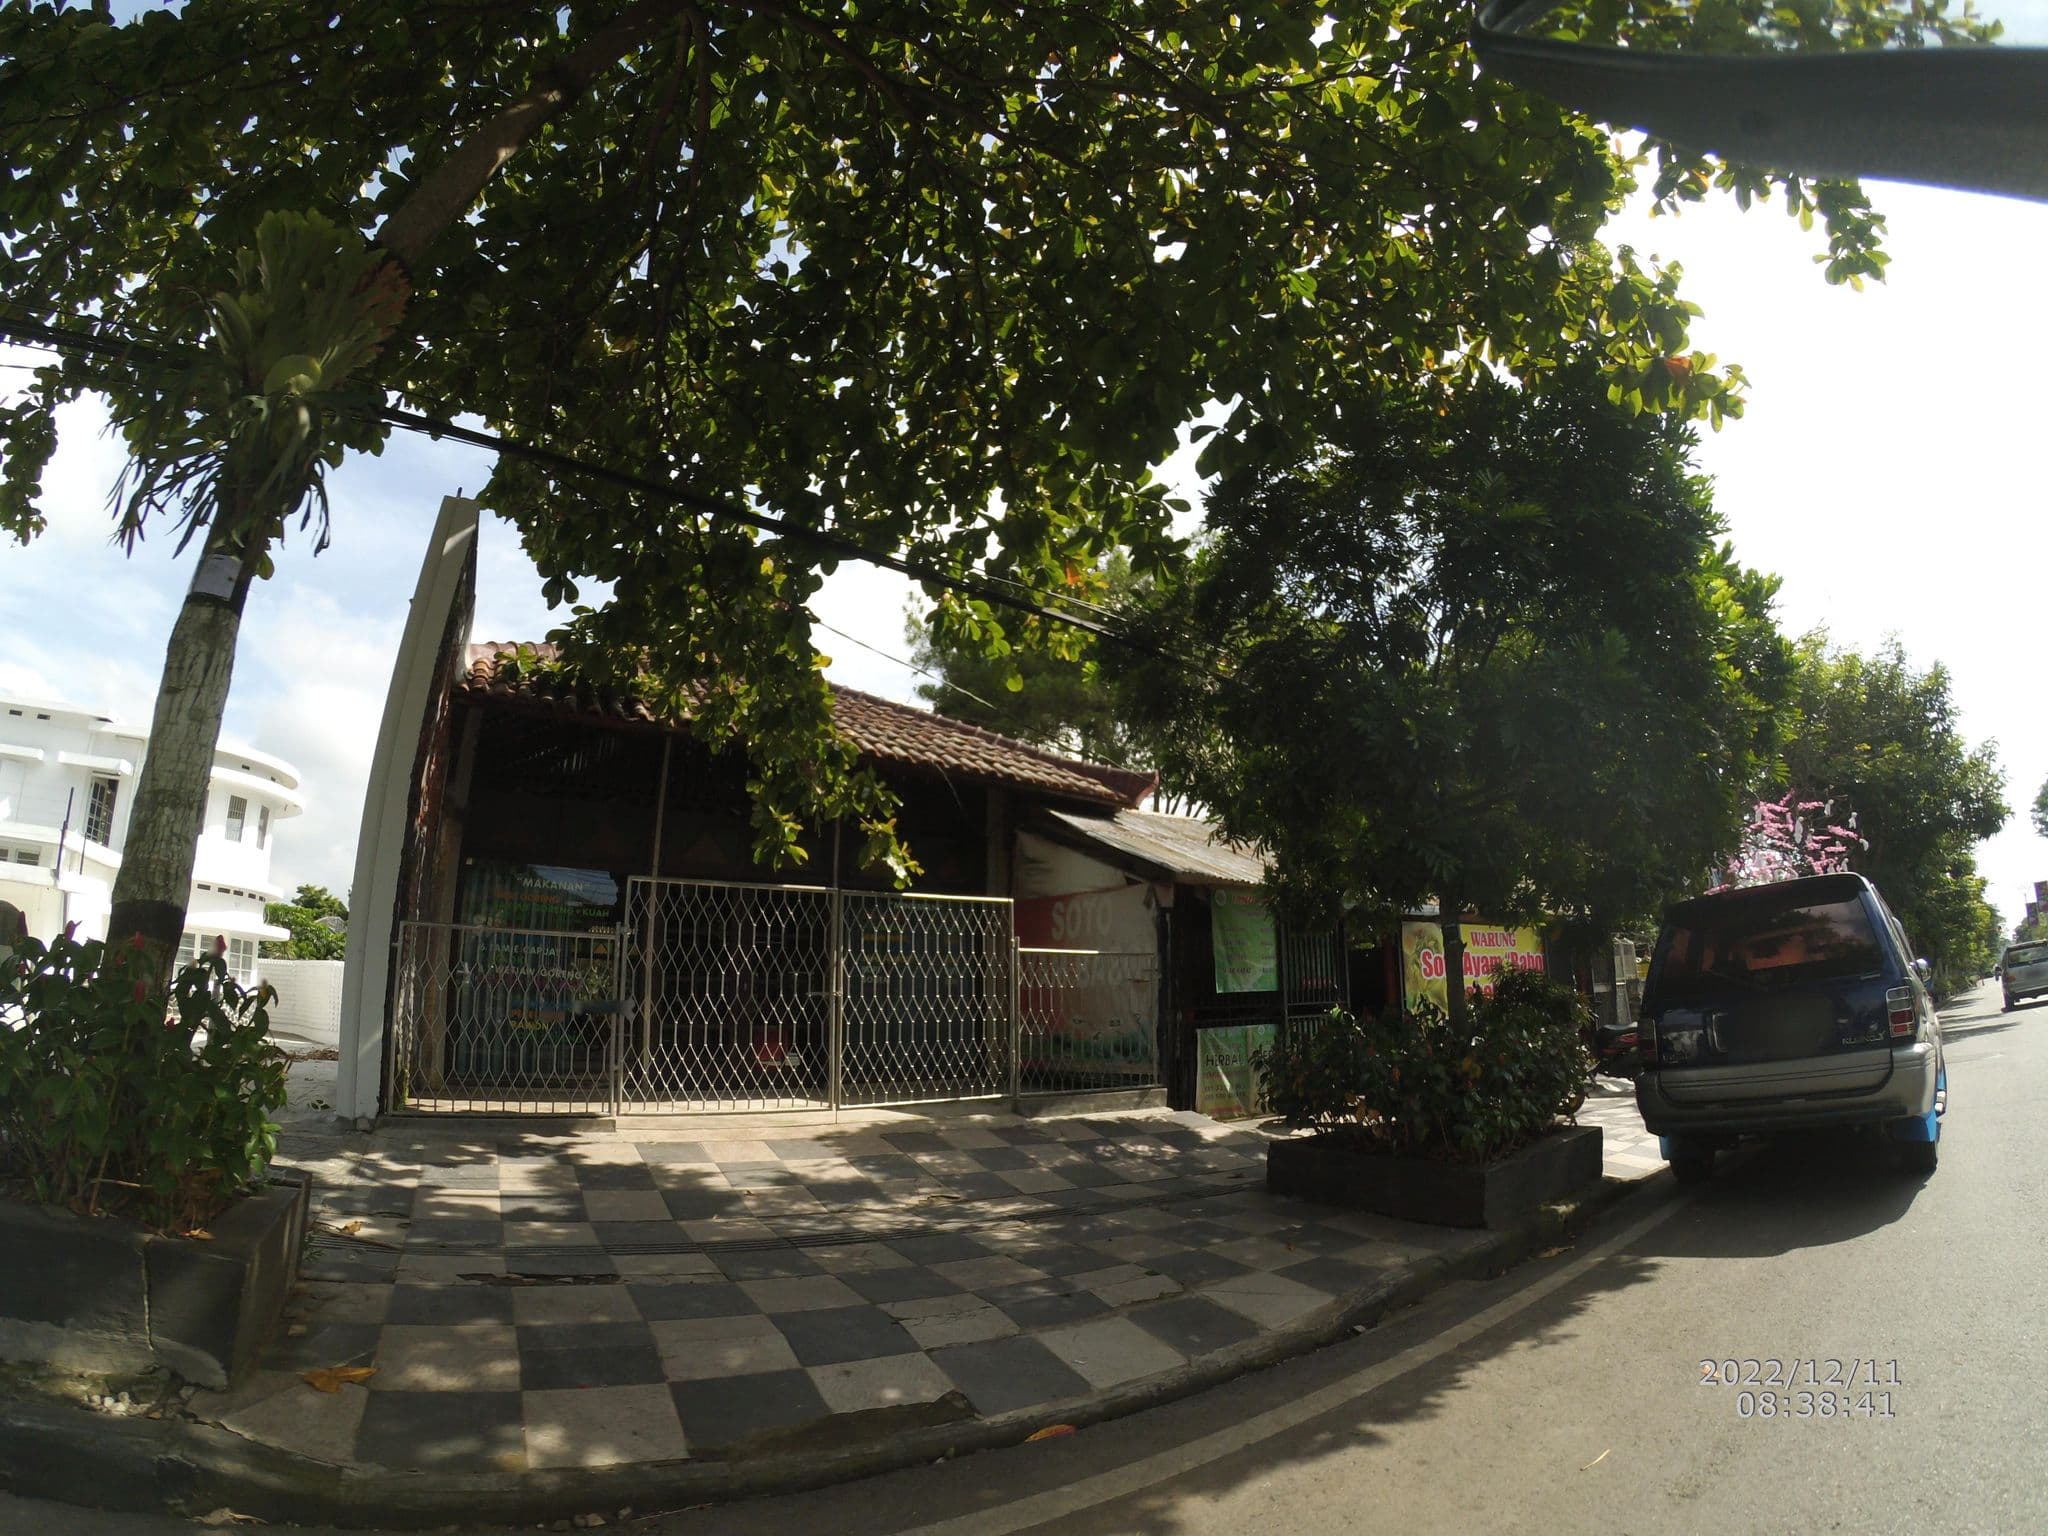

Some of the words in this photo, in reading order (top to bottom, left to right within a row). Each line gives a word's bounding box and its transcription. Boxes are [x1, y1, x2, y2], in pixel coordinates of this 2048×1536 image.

[1051, 899, 1112, 940] SOTO
[1470, 931, 1516, 947] WARUNG
[1421, 950, 1446, 977] So
